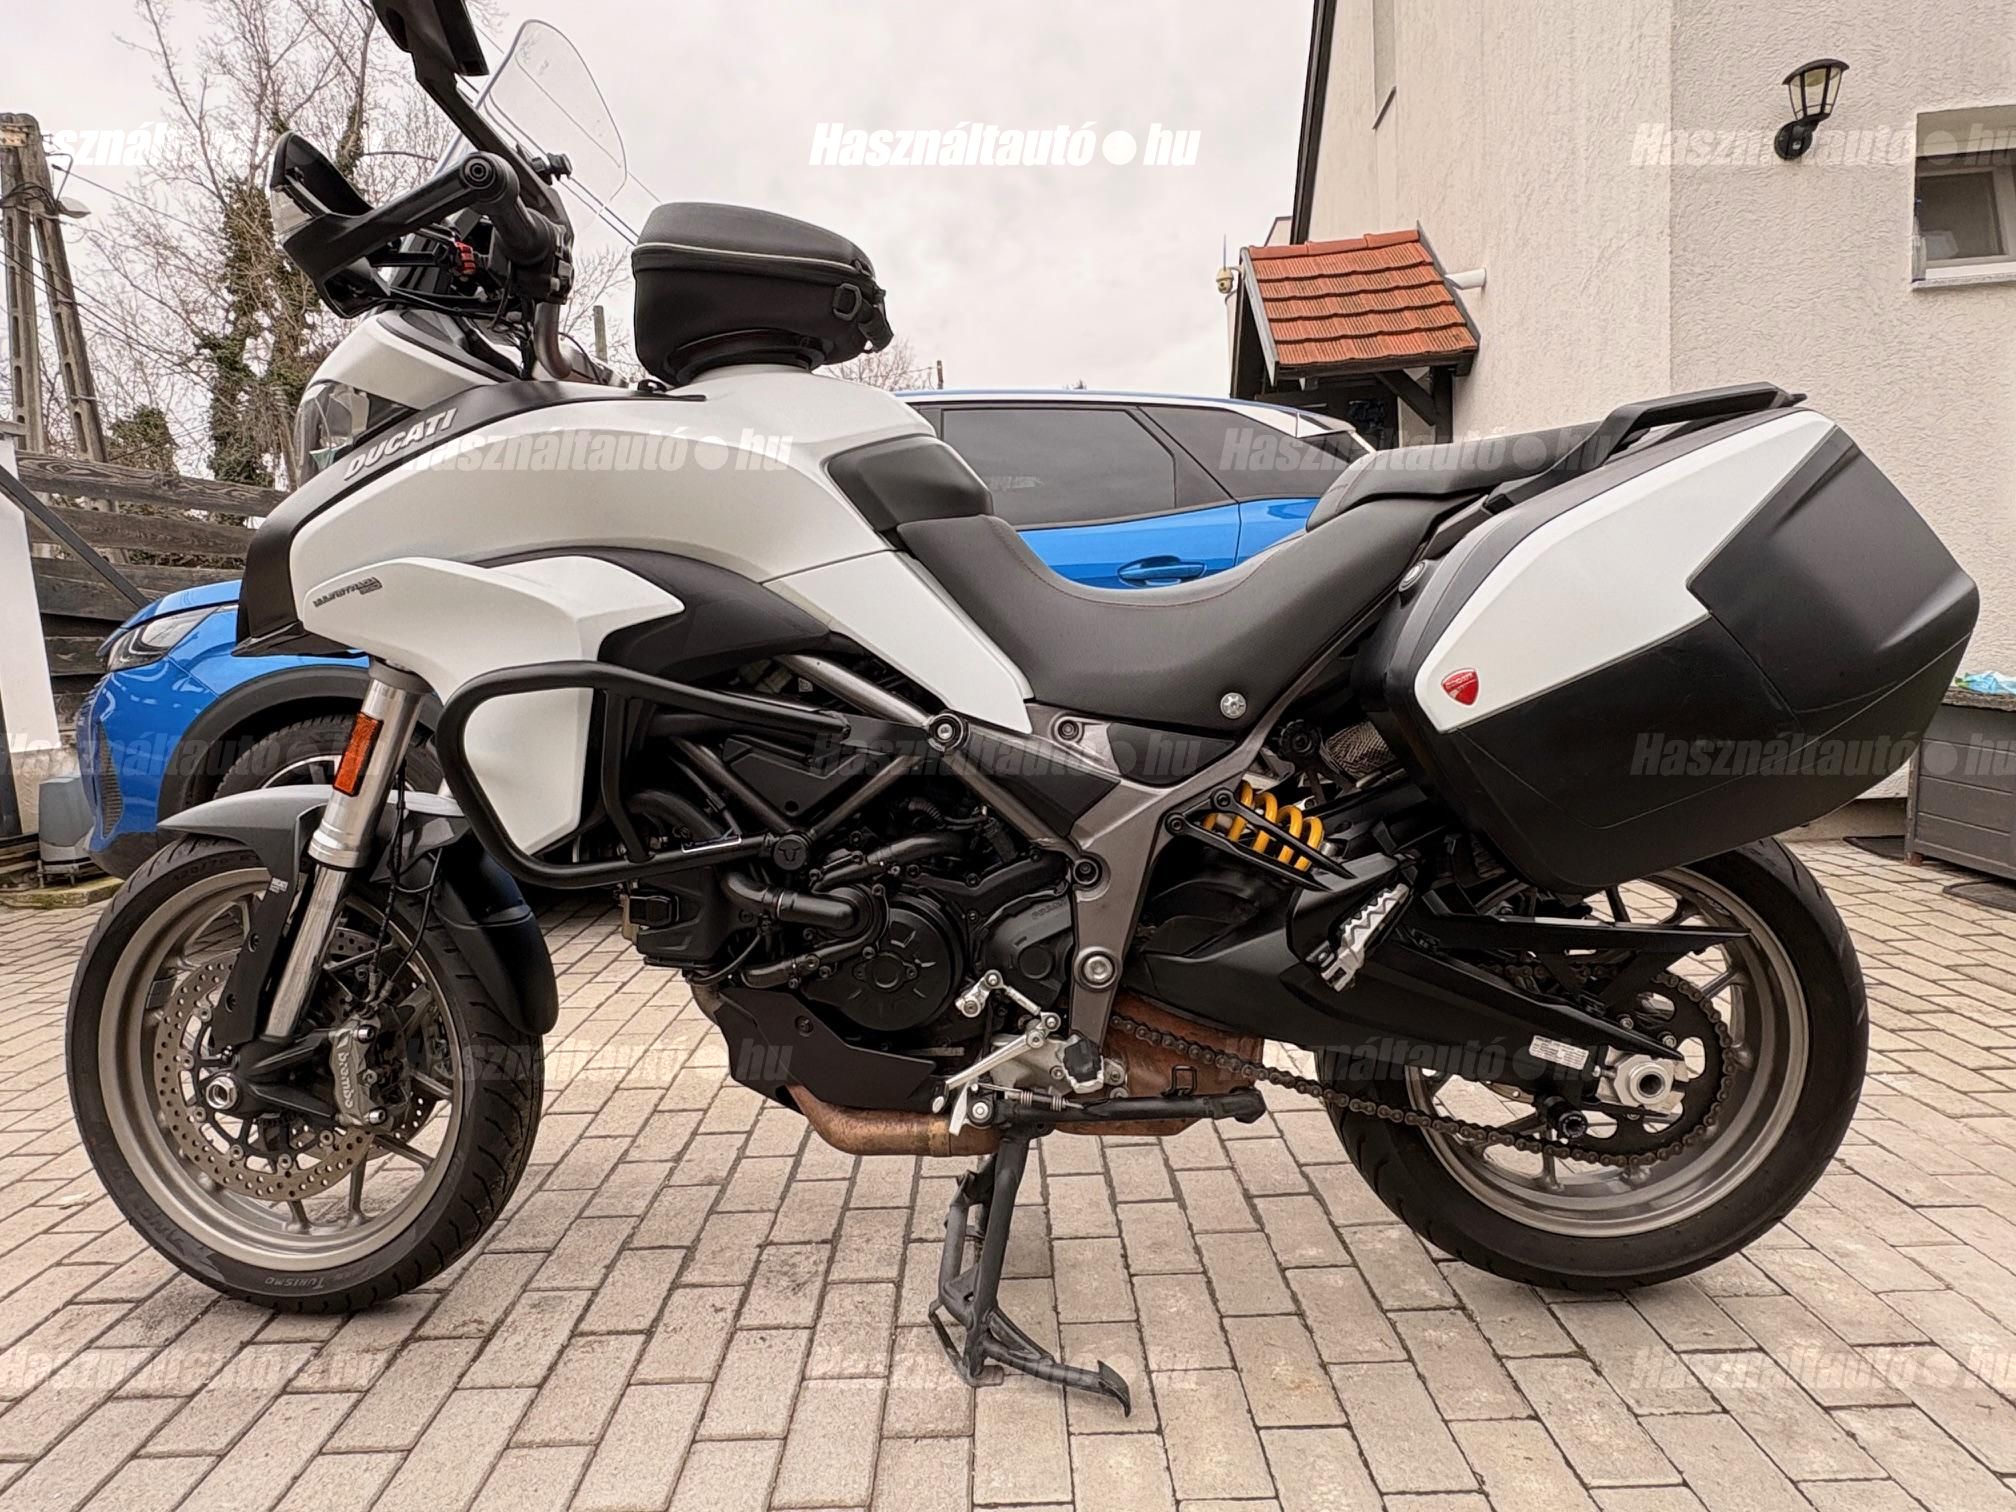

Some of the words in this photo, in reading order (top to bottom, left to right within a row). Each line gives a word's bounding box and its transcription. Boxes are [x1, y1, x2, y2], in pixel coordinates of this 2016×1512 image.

[344, 407, 458, 481] DUCATI
[337, 1052, 355, 1109] brembo
[265, 1275, 325, 1291] TURISMO
